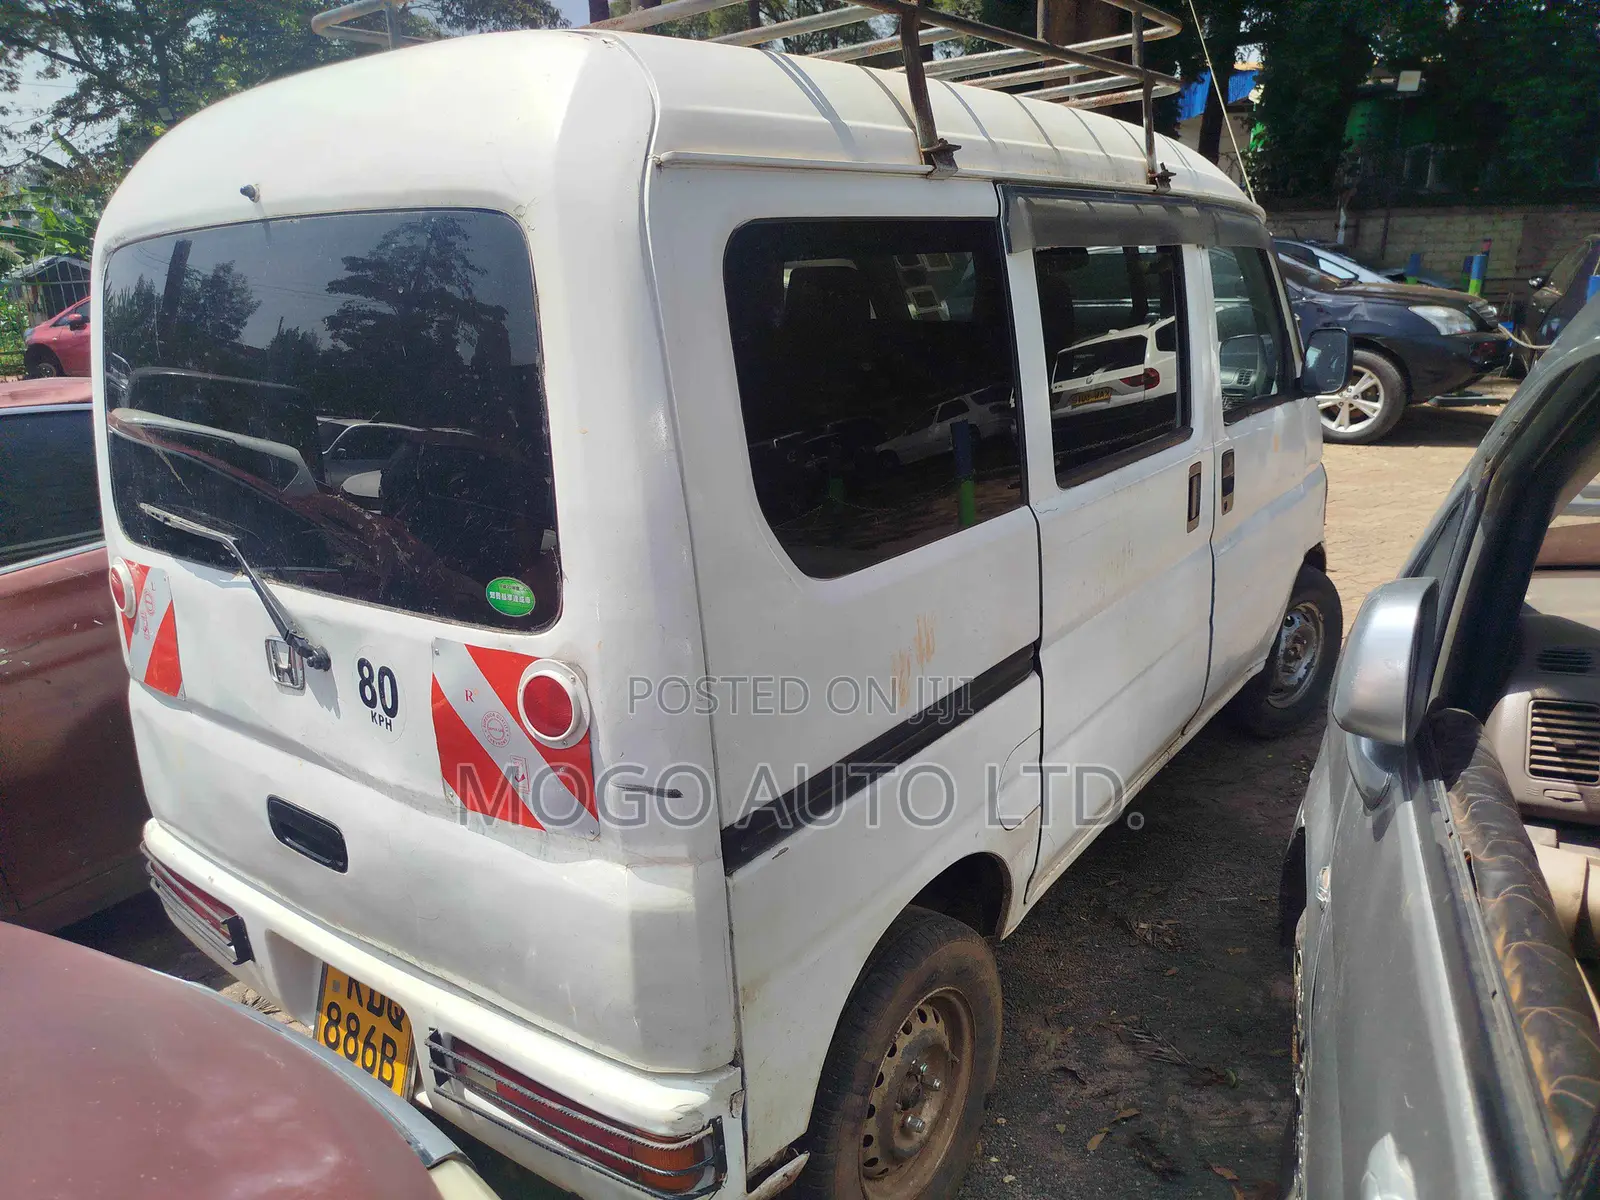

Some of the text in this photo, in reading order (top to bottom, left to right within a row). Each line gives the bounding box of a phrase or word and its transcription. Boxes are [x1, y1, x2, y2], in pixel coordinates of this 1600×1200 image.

[357, 657, 398, 719] 80
[370, 710, 393, 732] KPH
[323, 1001, 397, 1089] 886B
